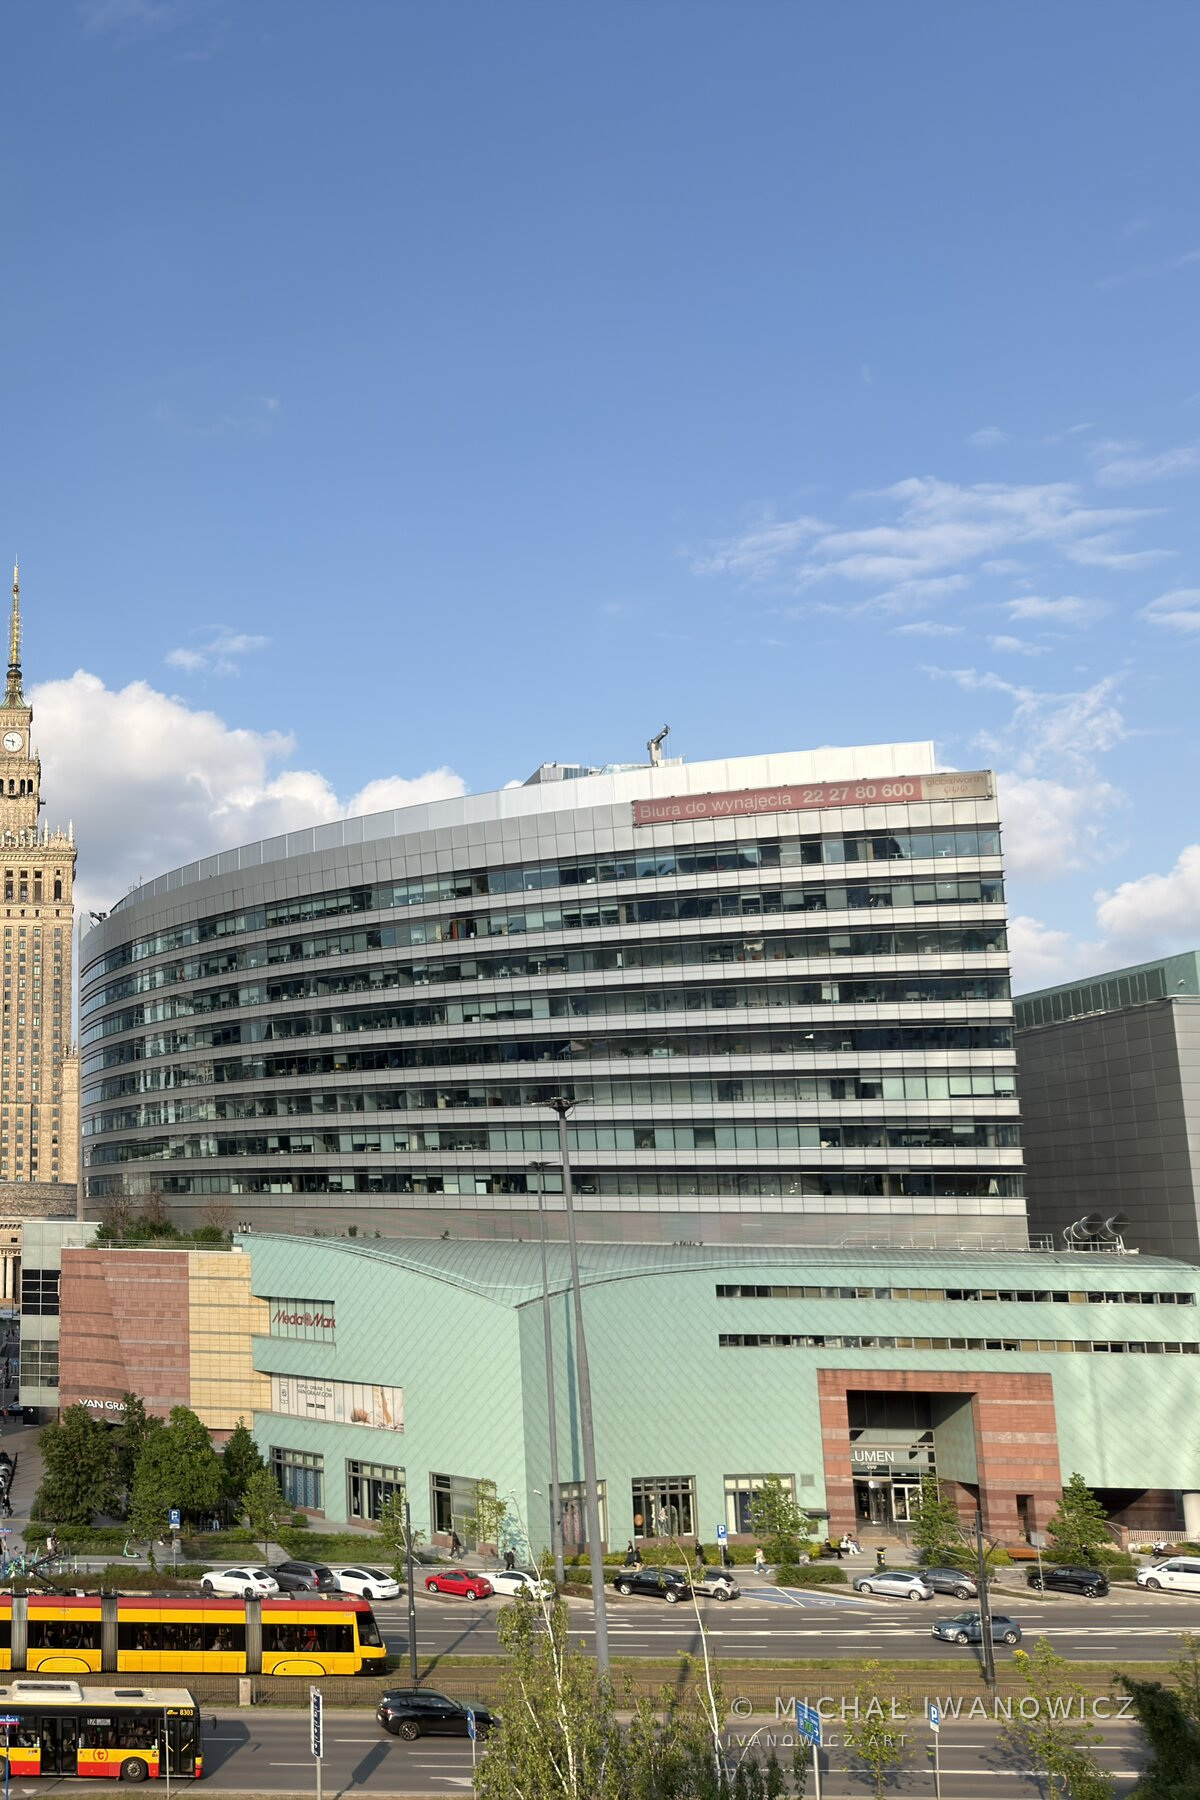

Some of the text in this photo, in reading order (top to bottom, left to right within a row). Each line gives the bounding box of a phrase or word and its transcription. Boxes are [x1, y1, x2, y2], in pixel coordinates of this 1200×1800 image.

[640, 782, 914, 818] Biura do wynajęcia 22 27 80 600
[79, 1399, 103, 1408] VAN
